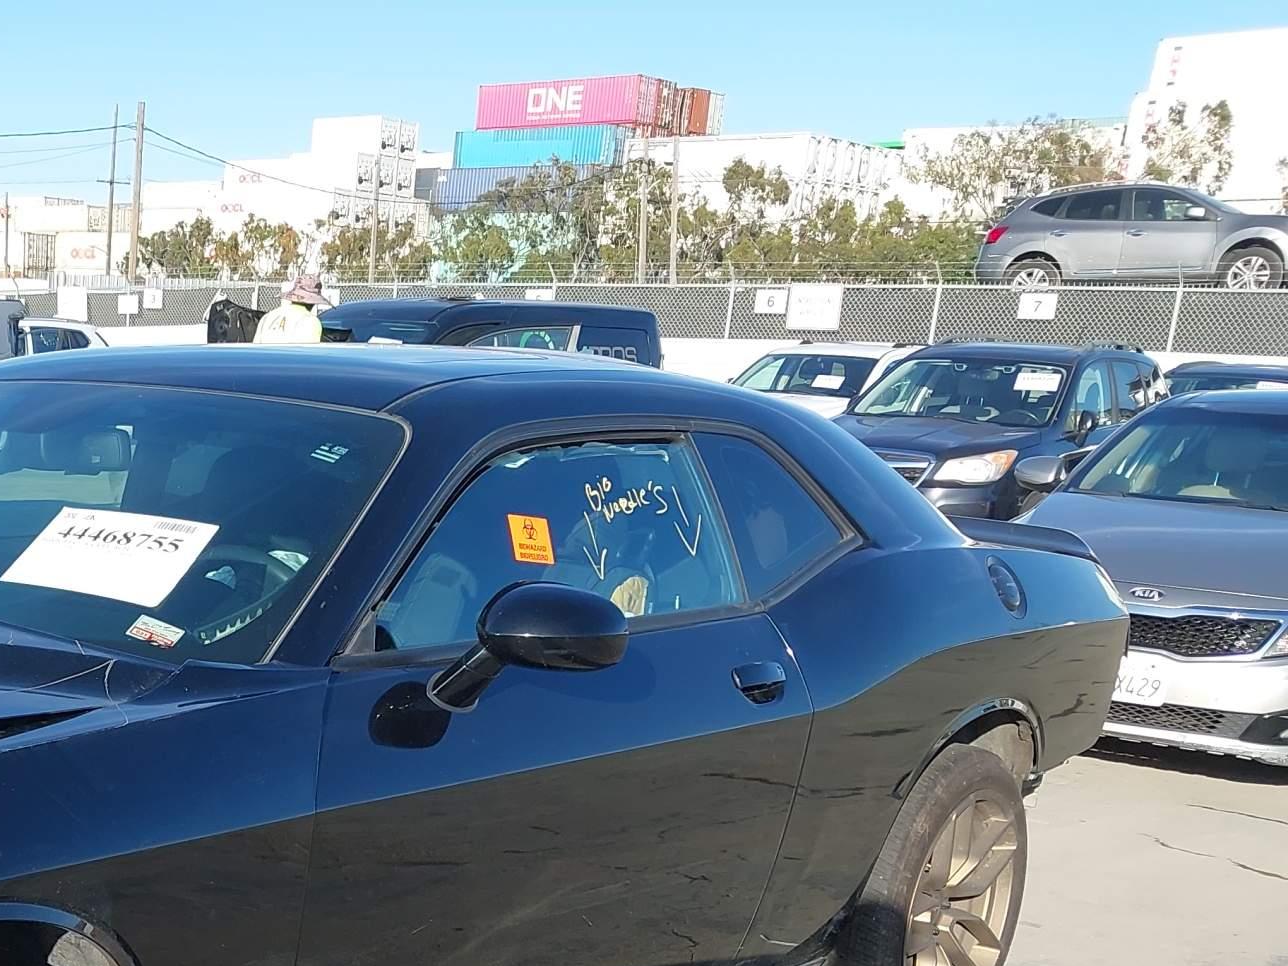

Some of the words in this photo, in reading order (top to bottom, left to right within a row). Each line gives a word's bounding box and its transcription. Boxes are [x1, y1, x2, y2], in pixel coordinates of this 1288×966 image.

[526, 85, 585, 113] ONE
[70, 248, 96, 259] OOCL
[767, 295, 775, 308] 6
[1033, 300, 1043, 313] 7
[58, 524, 185, 554] 44468755
[1134, 589, 1159, 600] KIA
